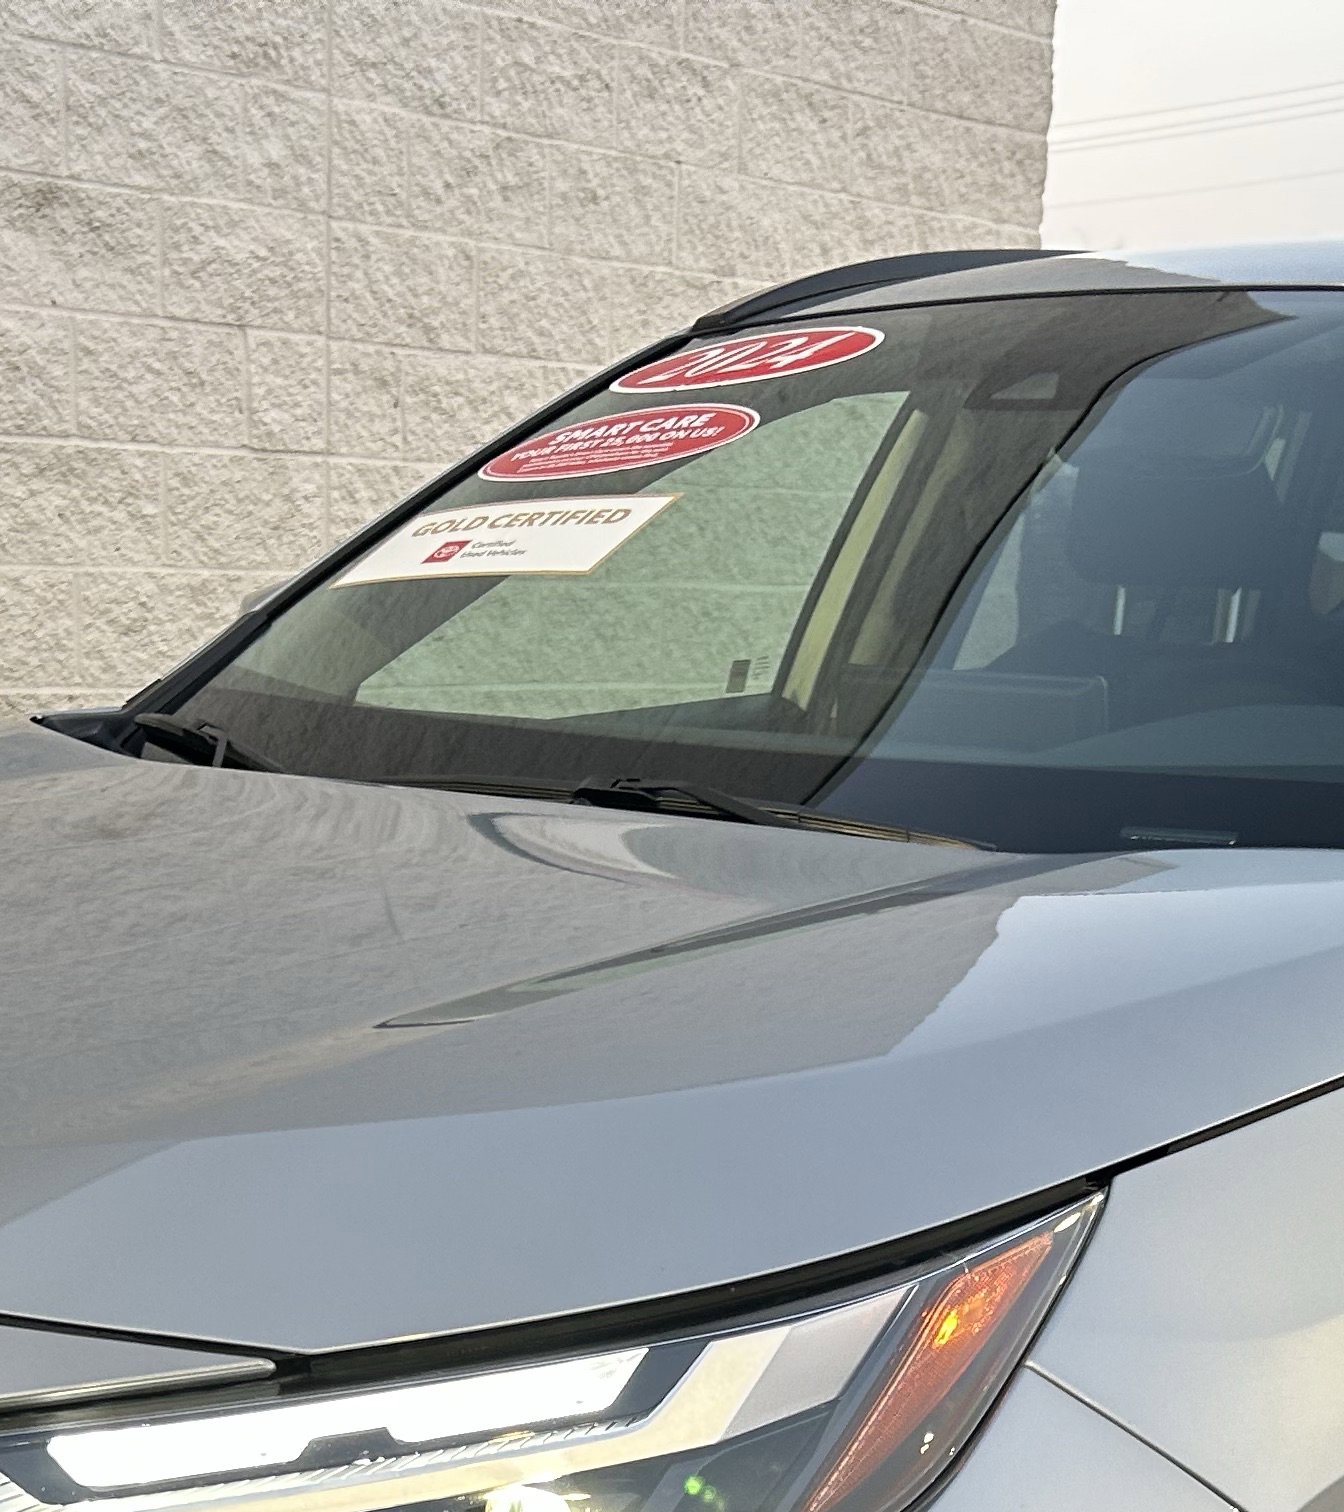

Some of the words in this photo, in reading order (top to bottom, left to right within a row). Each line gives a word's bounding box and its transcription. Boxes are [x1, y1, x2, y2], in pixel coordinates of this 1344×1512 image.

[637, 331, 856, 385] 2024
[511, 446, 555, 462] YOUR
[555, 438, 602, 455] FIRST
[663, 428, 692, 441] ON
[690, 426, 726, 439] US!
[549, 420, 643, 446] SMART
[642, 412, 717, 435] CARE
[411, 515, 490, 538] GOLD
[487, 508, 632, 530] CERTIFIED
